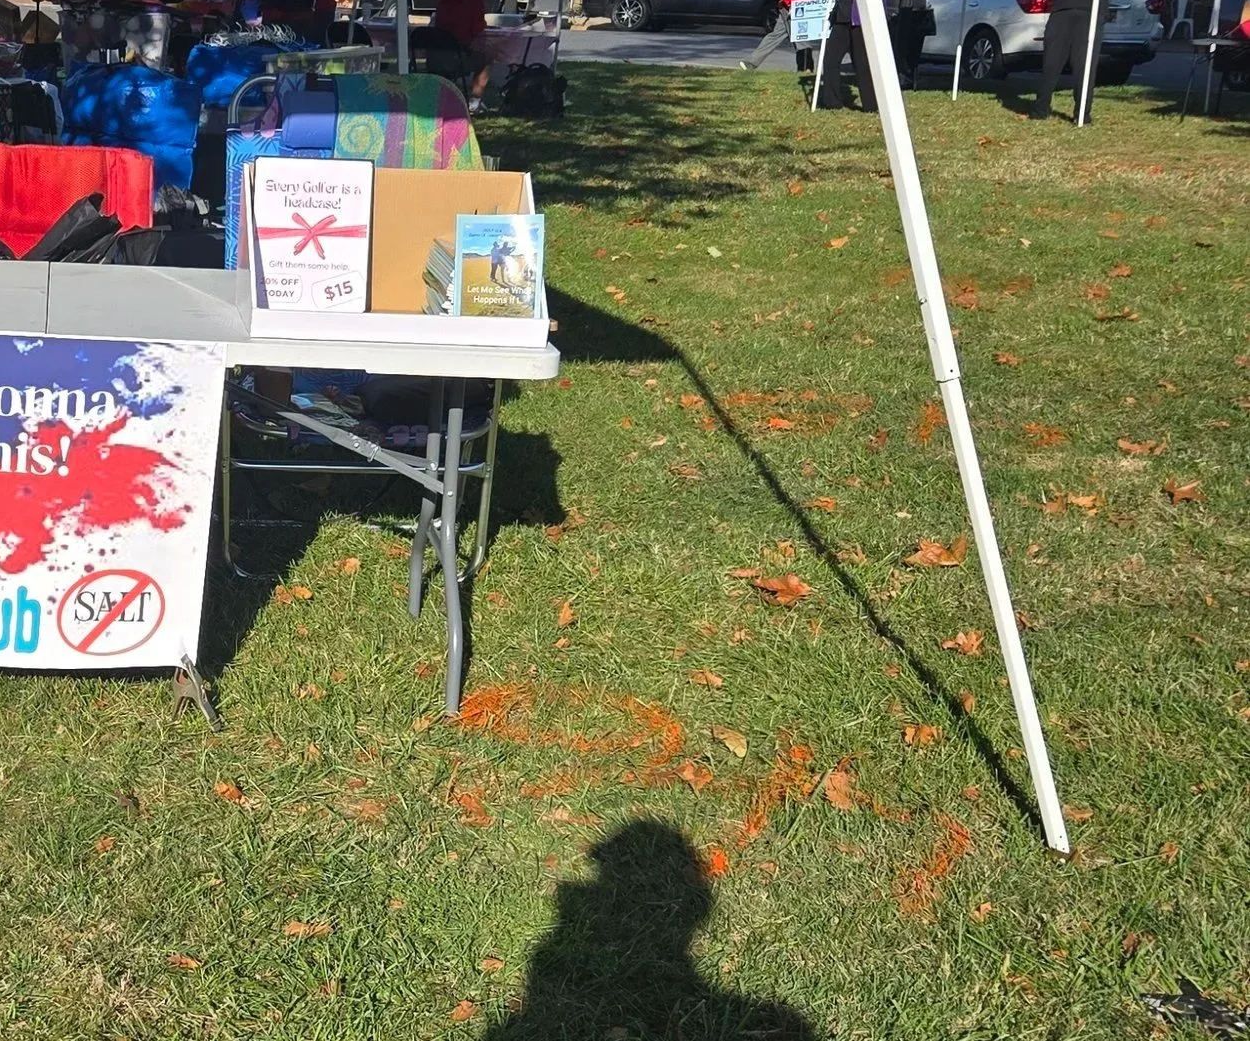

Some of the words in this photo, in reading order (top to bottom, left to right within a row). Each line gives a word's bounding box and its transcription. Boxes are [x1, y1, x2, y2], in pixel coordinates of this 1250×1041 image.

[266, 179, 299, 196] Every
[303, 181, 338, 195] Golfer
[341, 184, 351, 195] is
[354, 186, 361, 196] a
[284, 196, 341, 210] headcase!
[269, 260, 283, 269] Gift
[285, 261, 306, 269] them
[281, 278, 299, 286] OFF
[265, 290, 295, 298] TODAY
[324, 280, 354, 301] $15
[467, 285, 480, 294] Let
[481, 285, 493, 294] Me
[495, 286, 510, 294] See
[473, 295, 508, 305] Happens
[509, 296, 515, 304] If
[74, 591, 152, 623] SALT
